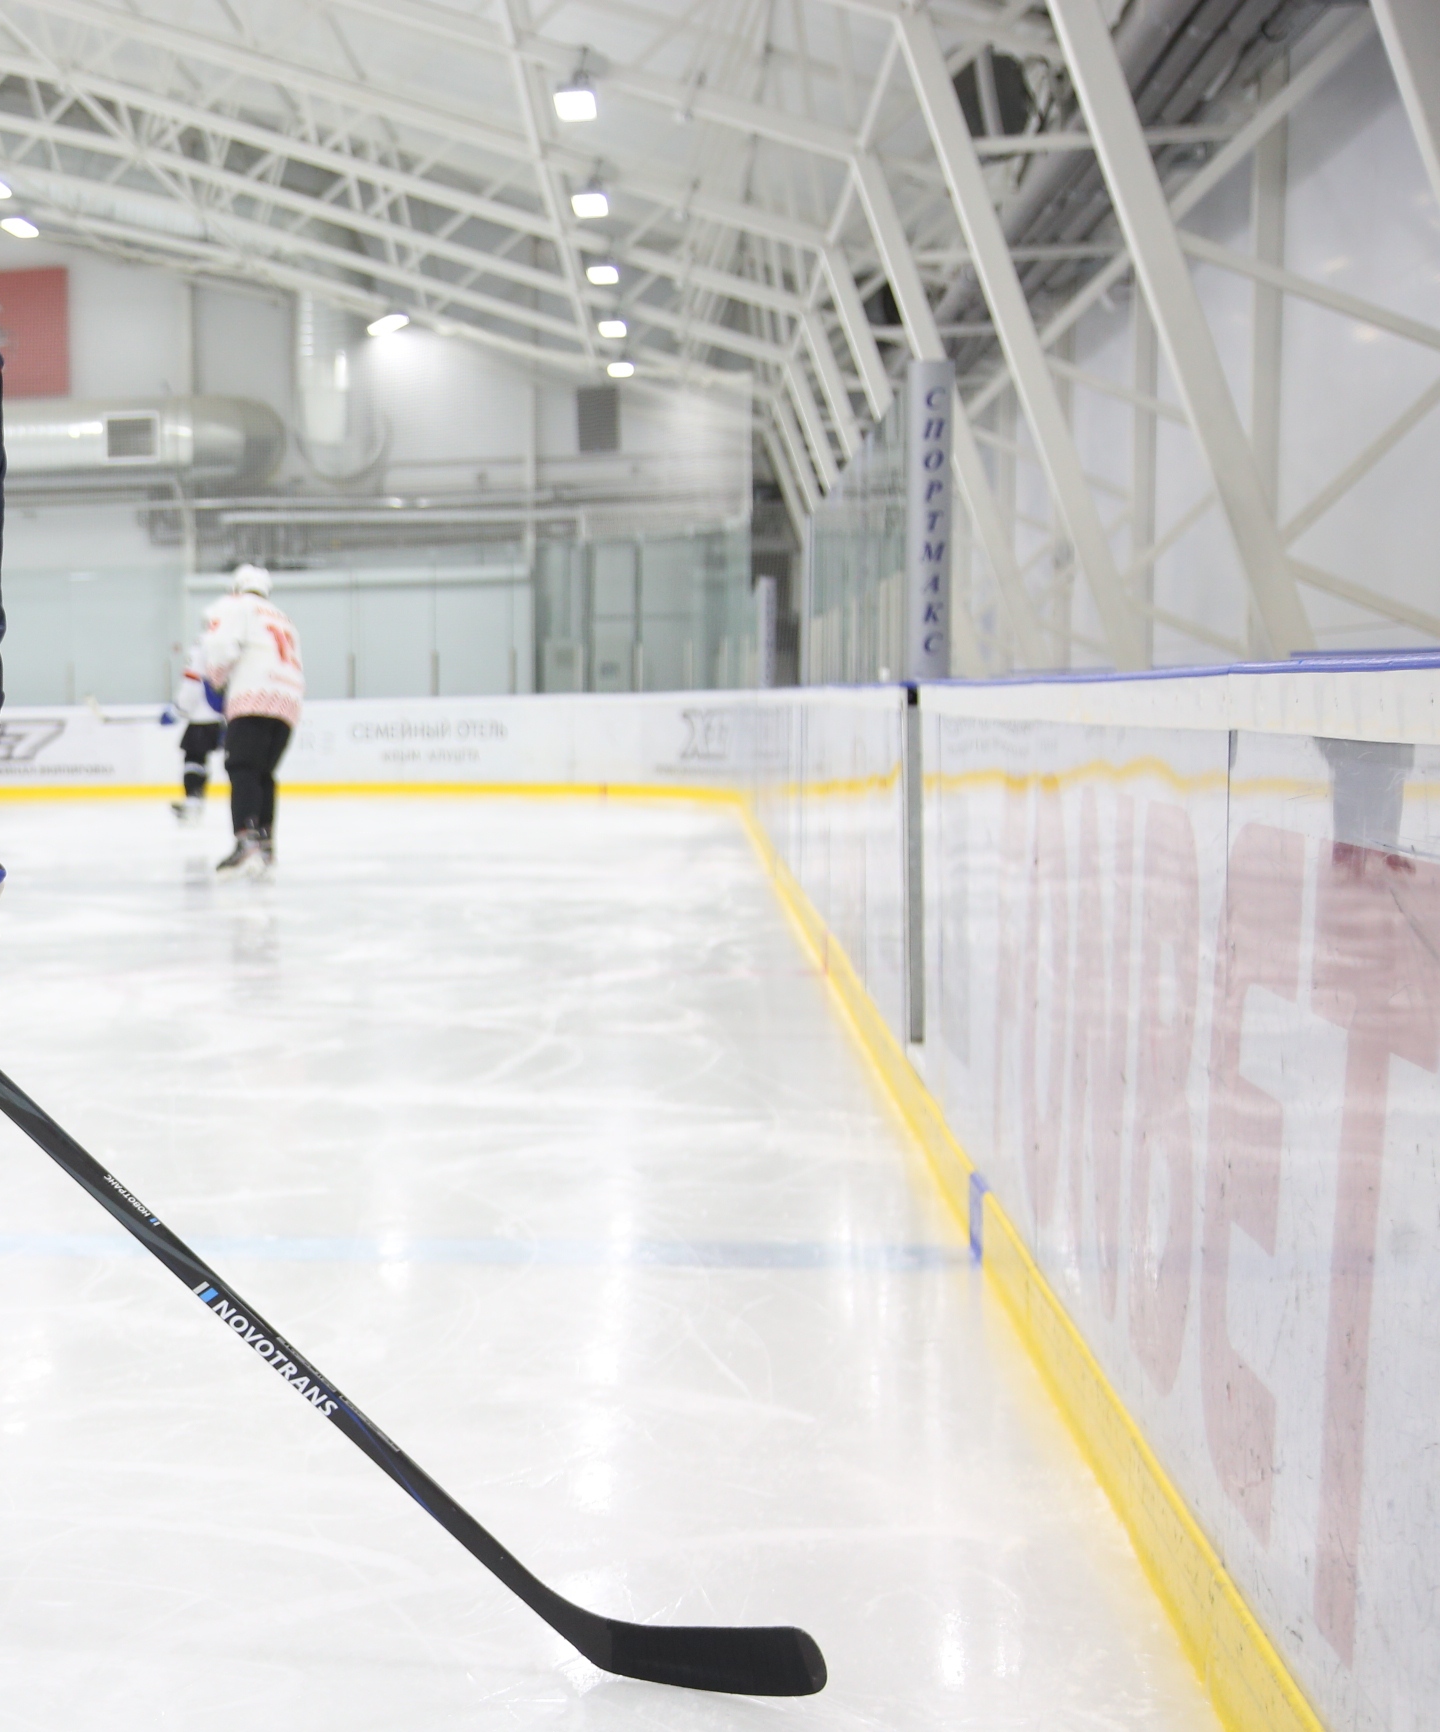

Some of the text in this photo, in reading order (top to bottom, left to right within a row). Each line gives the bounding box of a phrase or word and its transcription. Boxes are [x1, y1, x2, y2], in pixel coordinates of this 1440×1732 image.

[922, 386, 946, 653] СПОРТМАКС
[103, 1174, 151, 1218] НОВОТРАНС
[211, 1299, 339, 1417] NOVOTRANS
